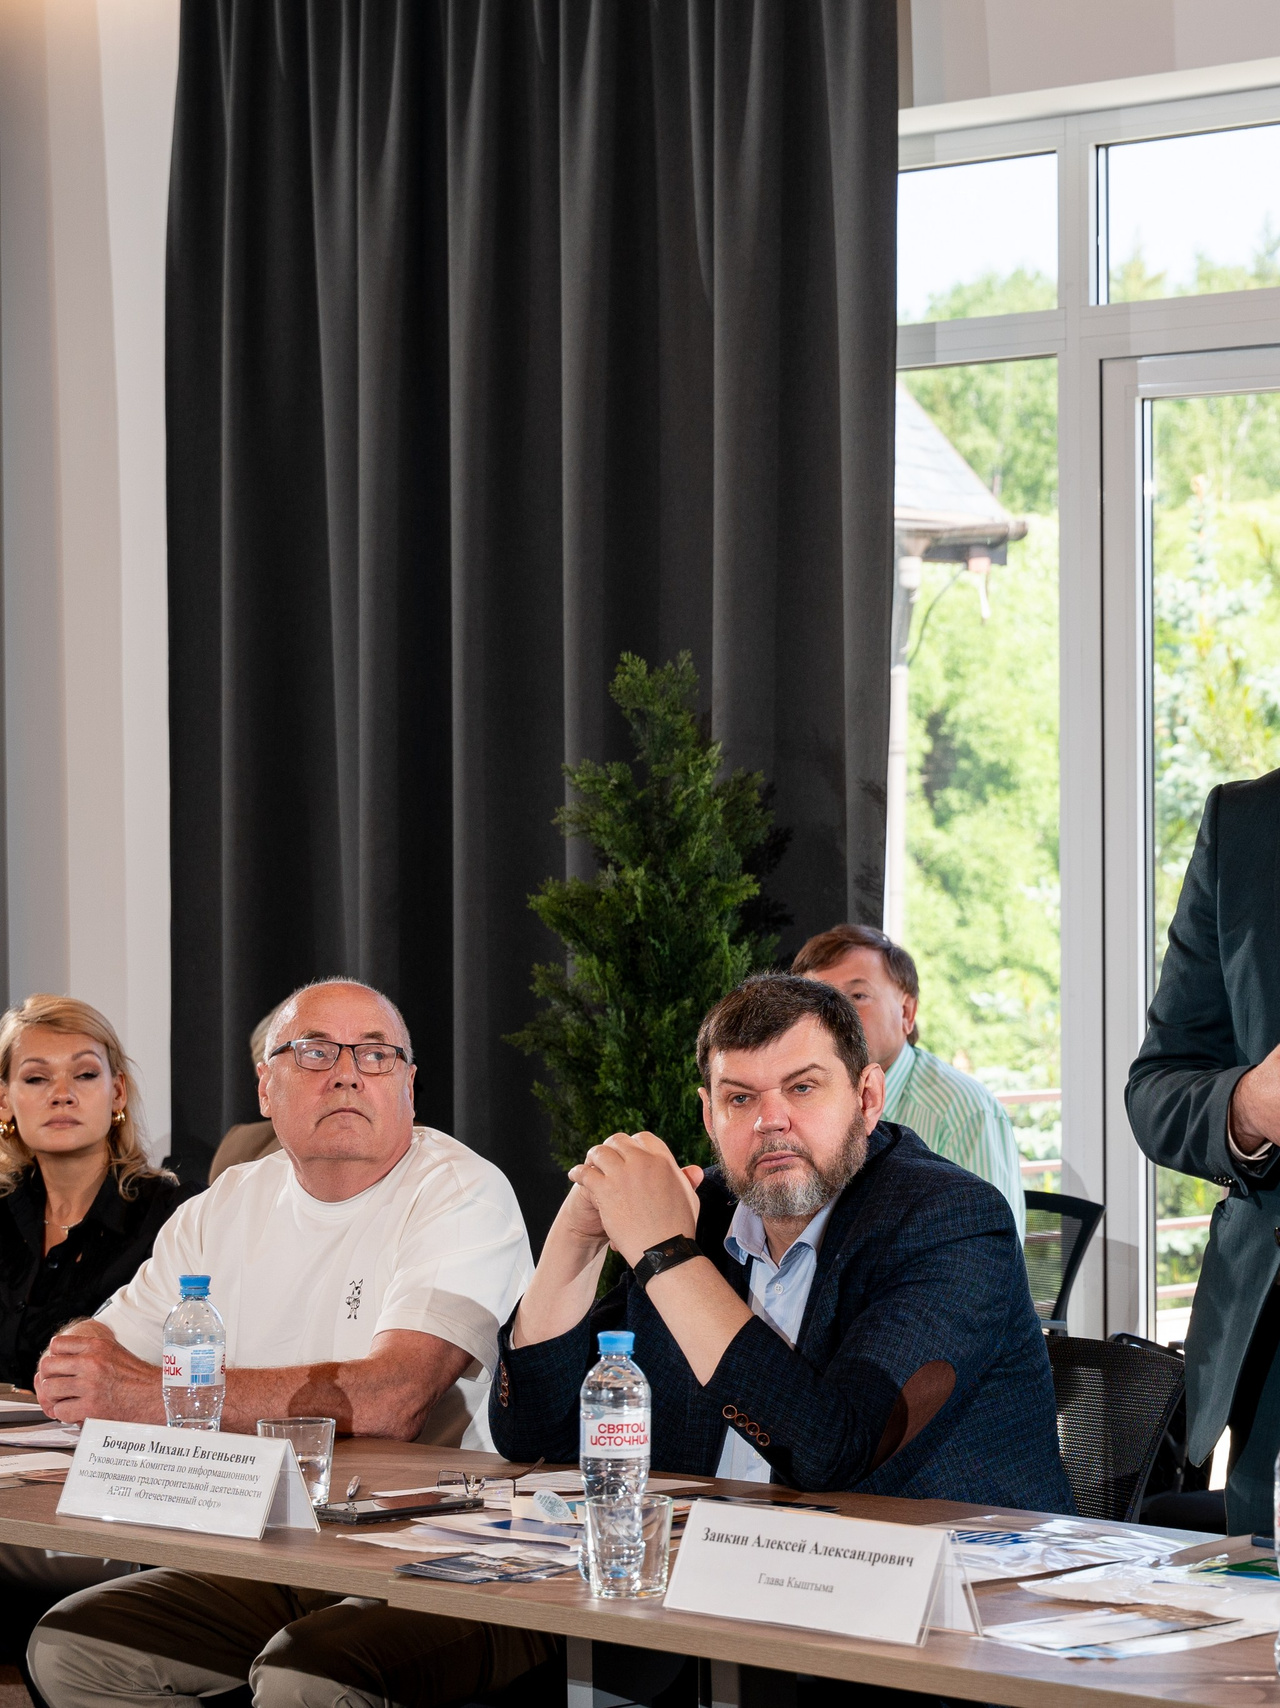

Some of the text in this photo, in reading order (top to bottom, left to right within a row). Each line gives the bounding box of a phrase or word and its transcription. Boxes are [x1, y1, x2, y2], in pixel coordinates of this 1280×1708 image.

[102, 1436, 256, 1465] Бочаров Михаил Евгеньевич
[88, 1452, 260, 1484] Руководитель Комитета по информационному
[79, 1468, 262, 1498] моделированию градостроительной деятельности
[134, 1489, 196, 1506] «Отечественный
[198, 1498, 221, 1509] софт»
[702, 1527, 915, 1567] Заикин Алексей Александрович
[757, 1572, 834, 1593] Глава Кыштыма
